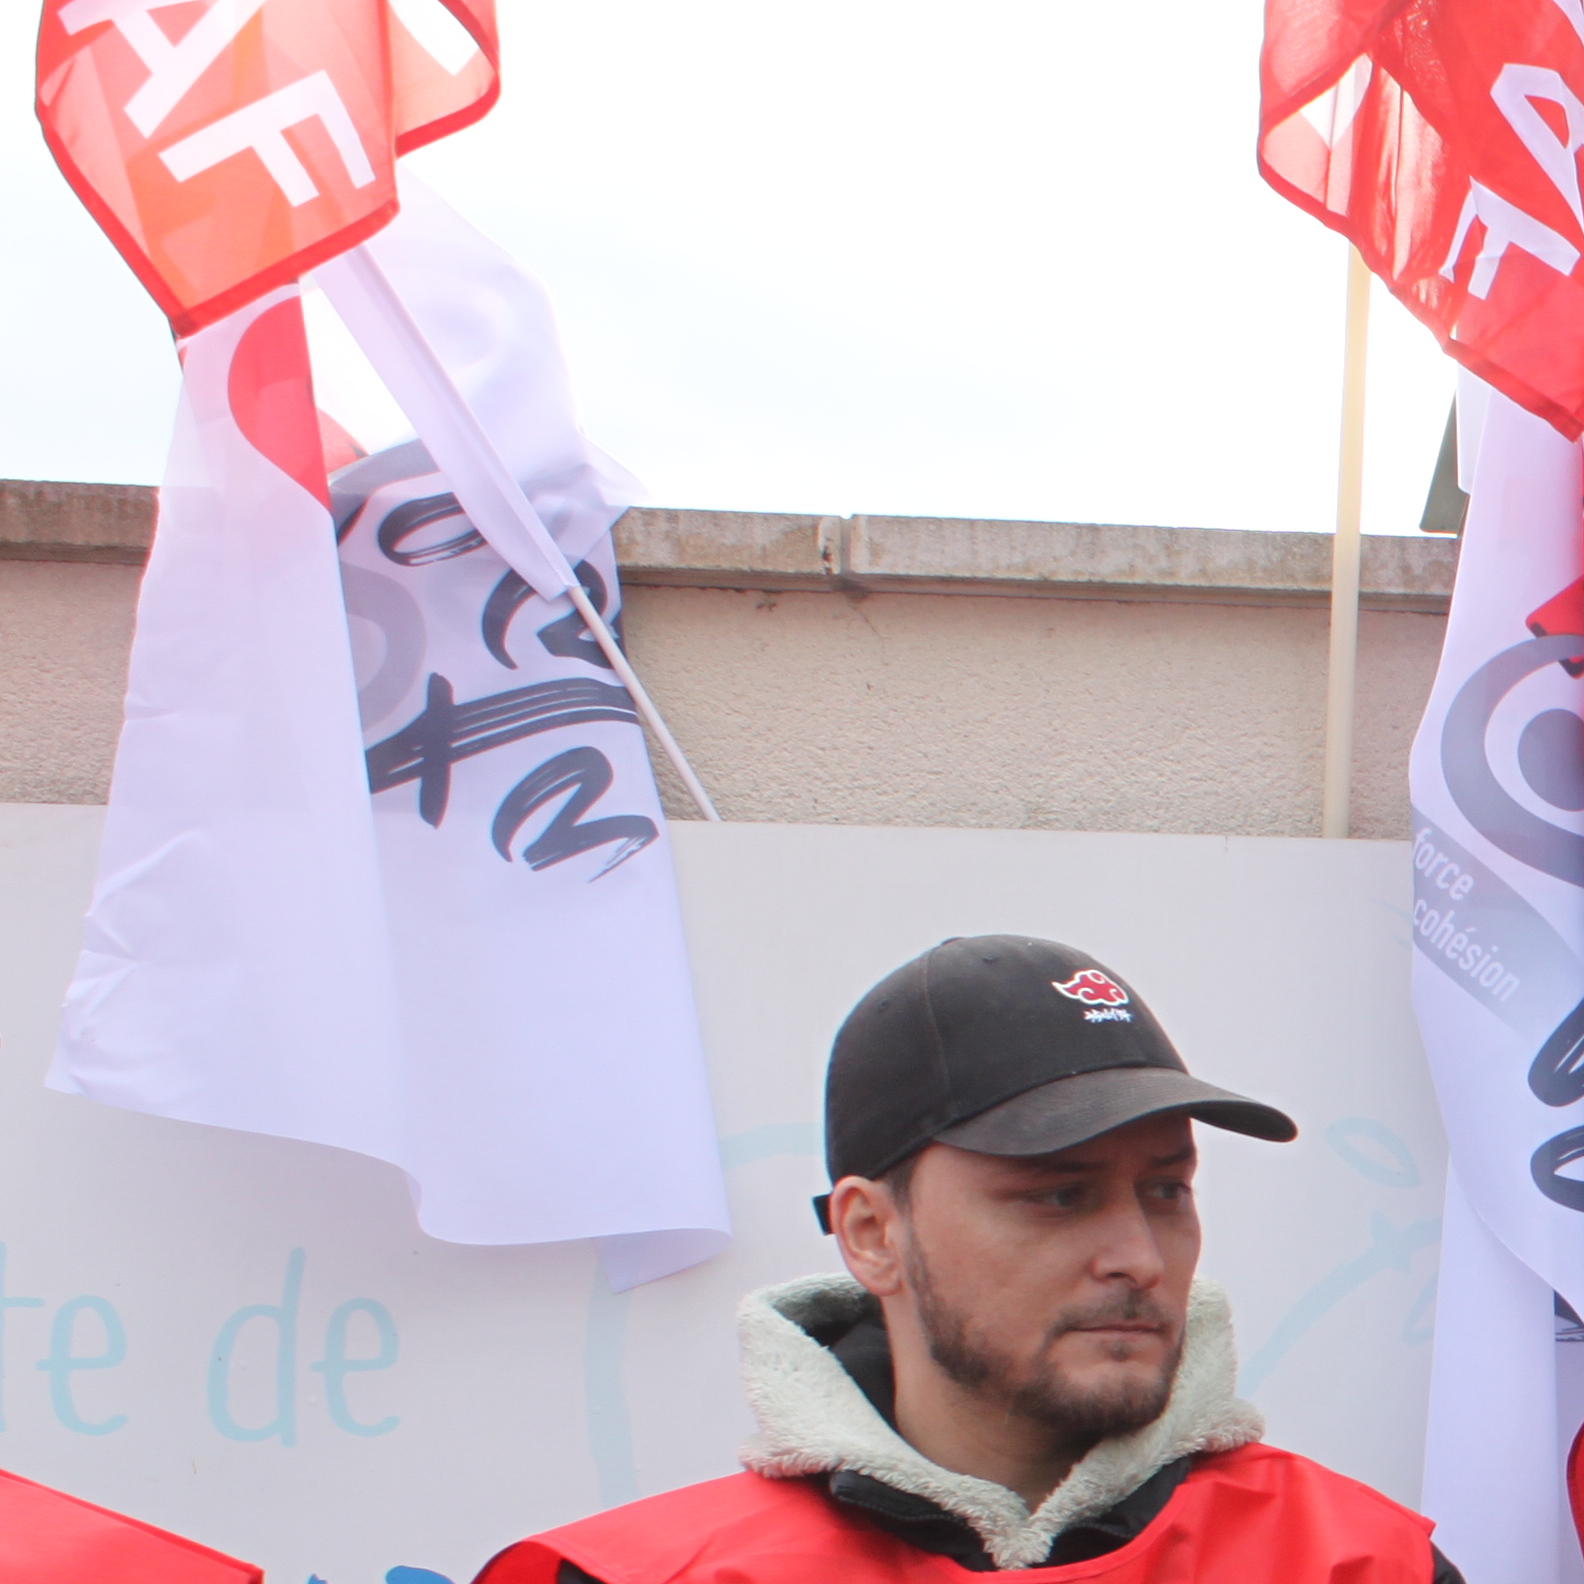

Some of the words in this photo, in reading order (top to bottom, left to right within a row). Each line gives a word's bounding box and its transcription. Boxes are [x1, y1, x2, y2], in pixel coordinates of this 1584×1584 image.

[1412, 827, 1474, 901] force
[1412, 896, 1521, 1001] cohésion
[206, 1246, 401, 1448] de
